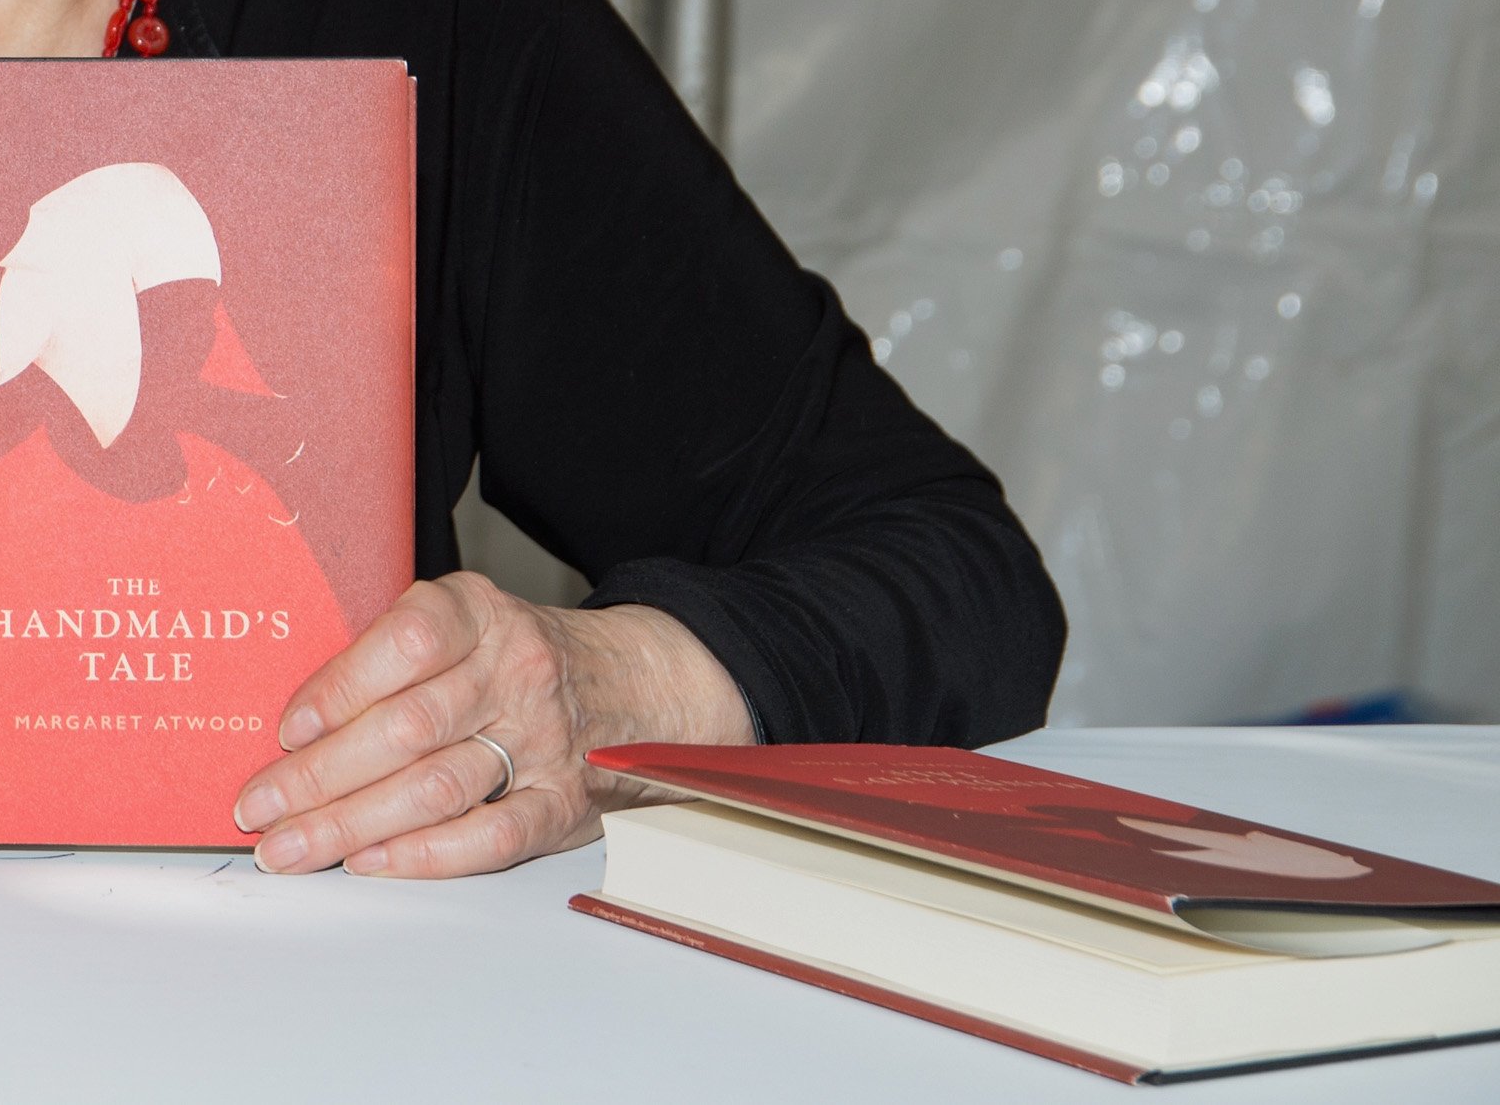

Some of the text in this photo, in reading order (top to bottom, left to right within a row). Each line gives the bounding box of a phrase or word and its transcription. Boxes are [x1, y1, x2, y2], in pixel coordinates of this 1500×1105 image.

[108, 579, 161, 595] THE
[80, 653, 192, 681] TALE
[16, 715, 262, 731] MARGARET ATWOOD
